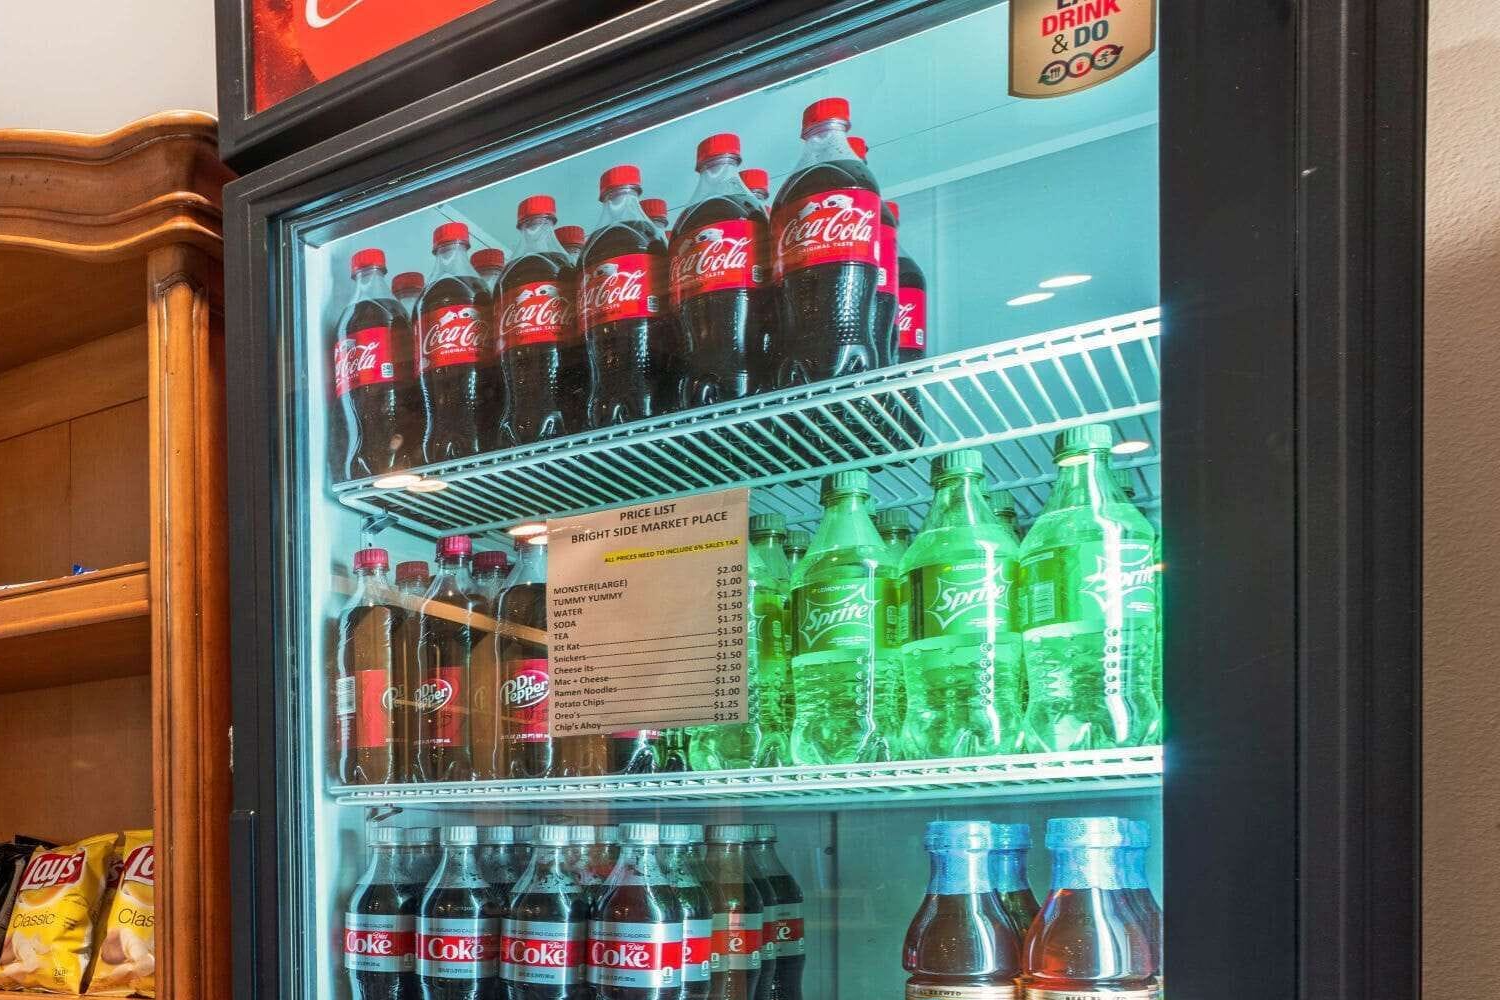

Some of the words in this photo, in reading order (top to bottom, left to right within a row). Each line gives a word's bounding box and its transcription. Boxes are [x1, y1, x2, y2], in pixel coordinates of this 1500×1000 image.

[1042, 1, 1122, 36] DRINK
[1051, 34, 1068, 54] &
[1074, 20, 1109, 48] DO
[620, 508, 650, 521] PRICE
[654, 503, 676, 516] LIST
[571, 529, 610, 544] BRIGHT
[613, 525, 638, 537] SIDE
[641, 517, 689, 533] MARKET
[692, 511, 728, 525] PLACE
[666, 545, 693, 555] INCLUDE
[705, 540, 724, 548] SALES
[553, 579, 628, 595] MONSTER(LARGE)
[717, 564, 743, 575] $2.00
[553, 596, 586, 607] TUMMY
[588, 591, 623, 602] YUMMY
[716, 577, 742, 588] $1.00
[553, 608, 583, 618] WATER
[717, 589, 742, 600] $1.25
[553, 620, 576, 629] SODA
[717, 601, 743, 612] $1.50
[554, 632, 569, 640] TEA
[717, 614, 743, 624] $1.75
[806, 602, 869, 631] Sprite
[566, 643, 581, 651] Kat
[717, 626, 743, 637] $1.50
[554, 655, 586, 664] Snickers
[717, 638, 743, 649] $1.50
[554, 667, 582, 675] Cheese
[716, 651, 742, 661] $1.50
[517, 675, 536, 688] Dr
[580, 676, 609, 684] Cheese
[716, 663, 742, 673] $2.50
[583, 686, 617, 695] Noodles
[715, 675, 741, 685] $1.50
[504, 680, 548, 706] Pepper
[583, 698, 605, 707] Chips
[714, 687, 740, 697] $1.00
[554, 712, 580, 720] Oreo's
[714, 700, 739, 709] $1.25
[554, 723, 579, 732] Chip's
[580, 721, 601, 731] Ahoy
[714, 712, 739, 722] $1.25
[20, 850, 86, 891] Lay's
[13, 912, 55, 929] Classic
[118, 908, 155, 927] Clas
[346, 931, 392, 955] Coke
[428, 937, 484, 960] Coke
[510, 941, 567, 965] Coke
[627, 942, 644, 951] Diet
[592, 942, 649, 969] Coke
